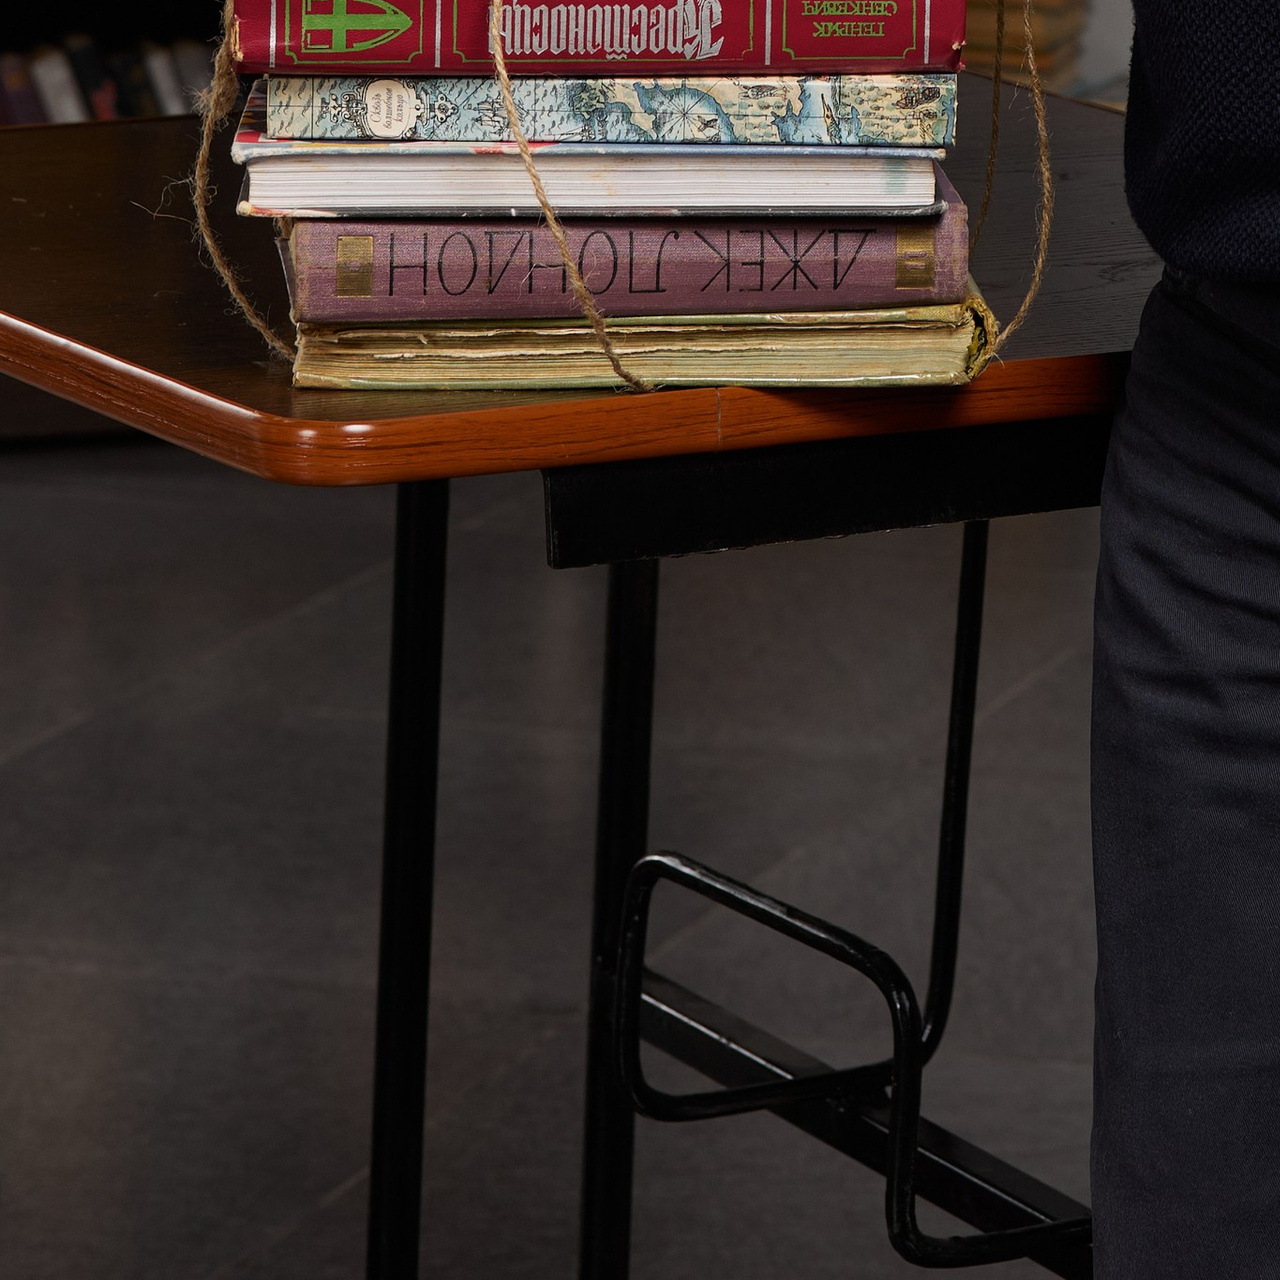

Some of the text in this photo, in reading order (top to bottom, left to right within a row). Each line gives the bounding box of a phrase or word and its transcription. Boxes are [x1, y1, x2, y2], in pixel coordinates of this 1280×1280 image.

[801, 0, 899, 17] СЕНКЕВИЧ
[812, 21, 886, 38] ГЕНРИК
[387, 228, 681, 297] ЛОНДОН
[693, 227, 878, 293] ДЖЕК
